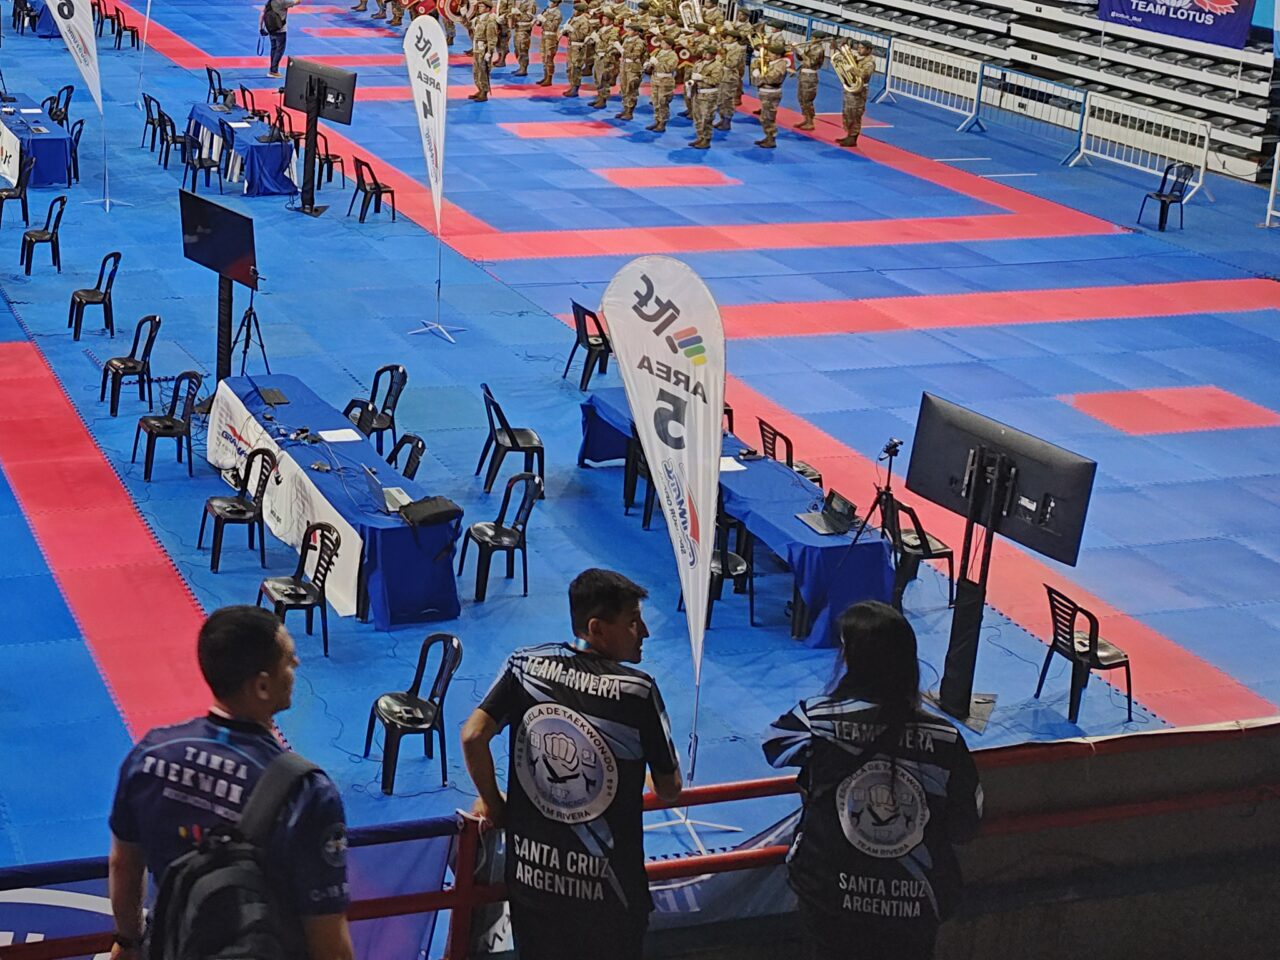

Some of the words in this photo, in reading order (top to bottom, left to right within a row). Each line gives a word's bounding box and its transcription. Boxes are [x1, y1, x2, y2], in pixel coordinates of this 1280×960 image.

[1131, 0, 1167, 16] TEAM
[1169, 8, 1215, 25] LOTUS
[524, 655, 563, 683] TEAM
[565, 667, 620, 700] RIVERA
[546, 706, 561, 716] DE
[561, 709, 614, 773] TAEKWON-DO
[556, 810, 591, 820] RIVERA
[514, 835, 560, 870] SANTA
[566, 851, 609, 879] CRUZ
[516, 861, 604, 902] ARGENTINA
[839, 872, 886, 896] SANTA
[891, 879, 927, 898] CRUZ
[842, 894, 921, 917] ARGENTINA
